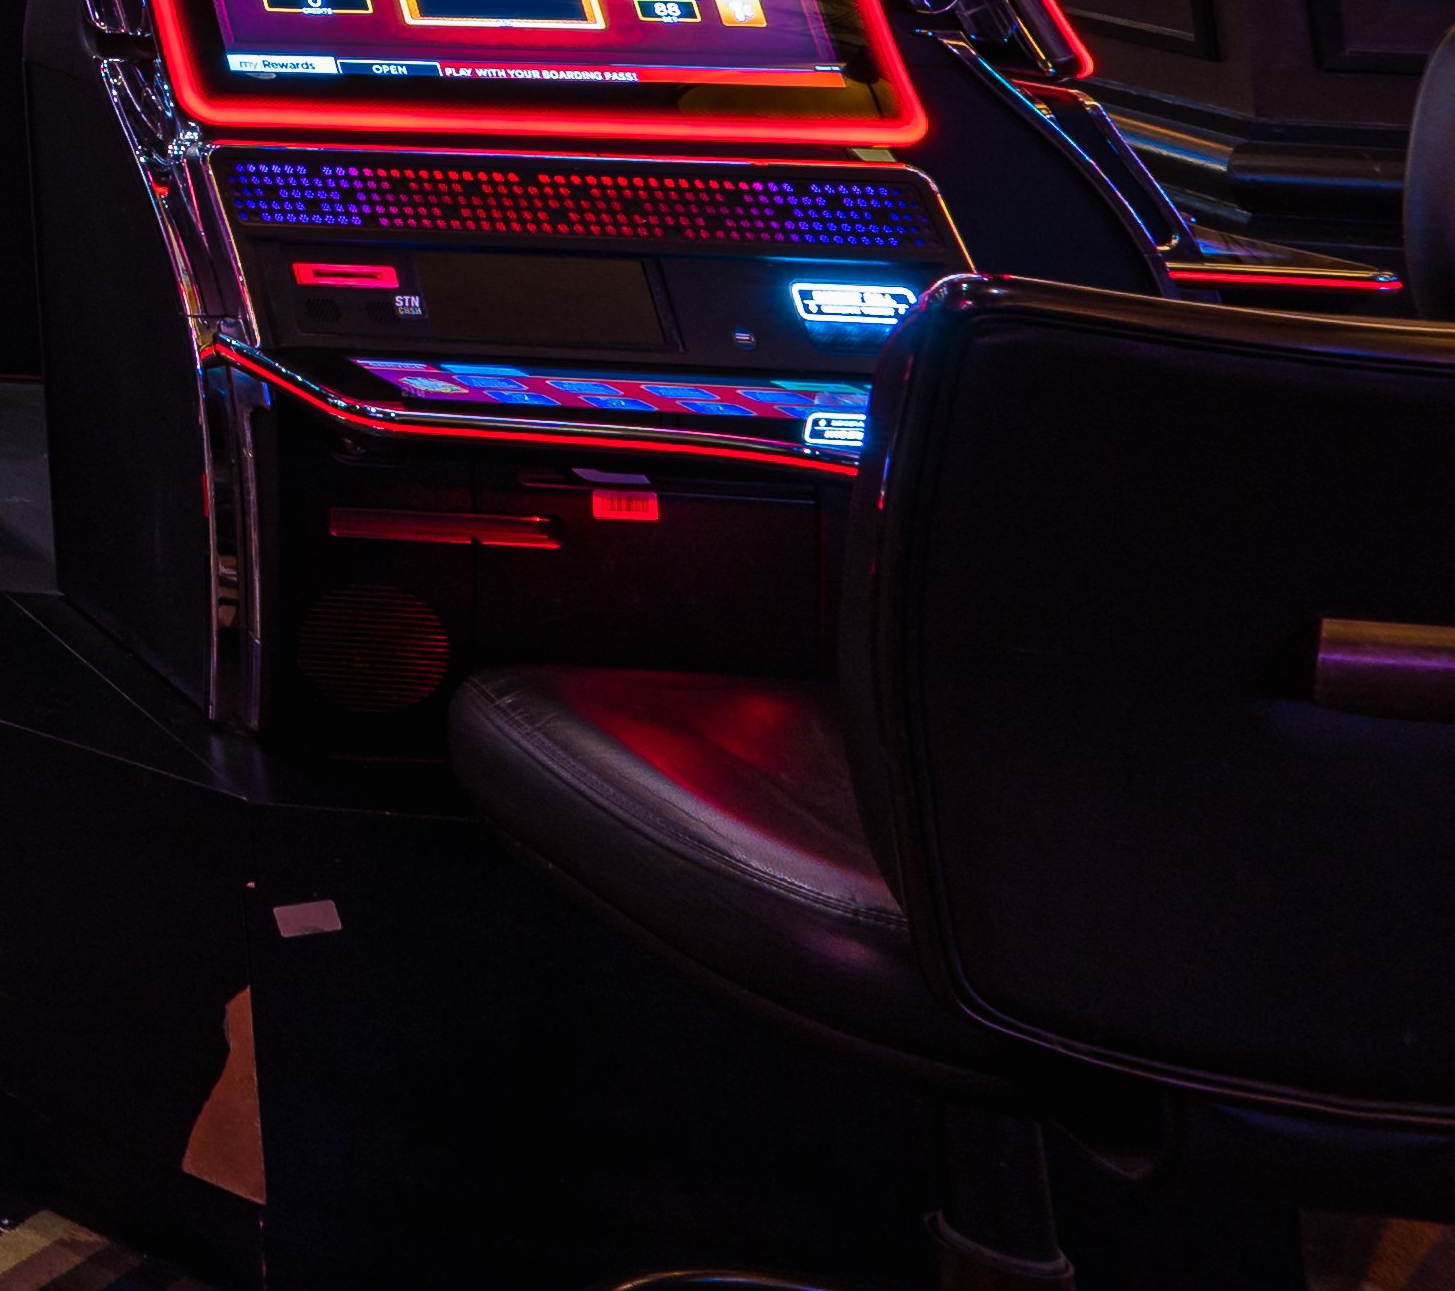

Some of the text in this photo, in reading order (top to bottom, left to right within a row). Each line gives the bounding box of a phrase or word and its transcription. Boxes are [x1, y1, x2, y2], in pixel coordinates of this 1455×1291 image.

[262, 60, 316, 70] Rewards
[372, 65, 408, 75] OPEN
[445, 67, 639, 82] PLAY WITH YOUR BOARDING PASS!
[395, 295, 420, 307] STN
